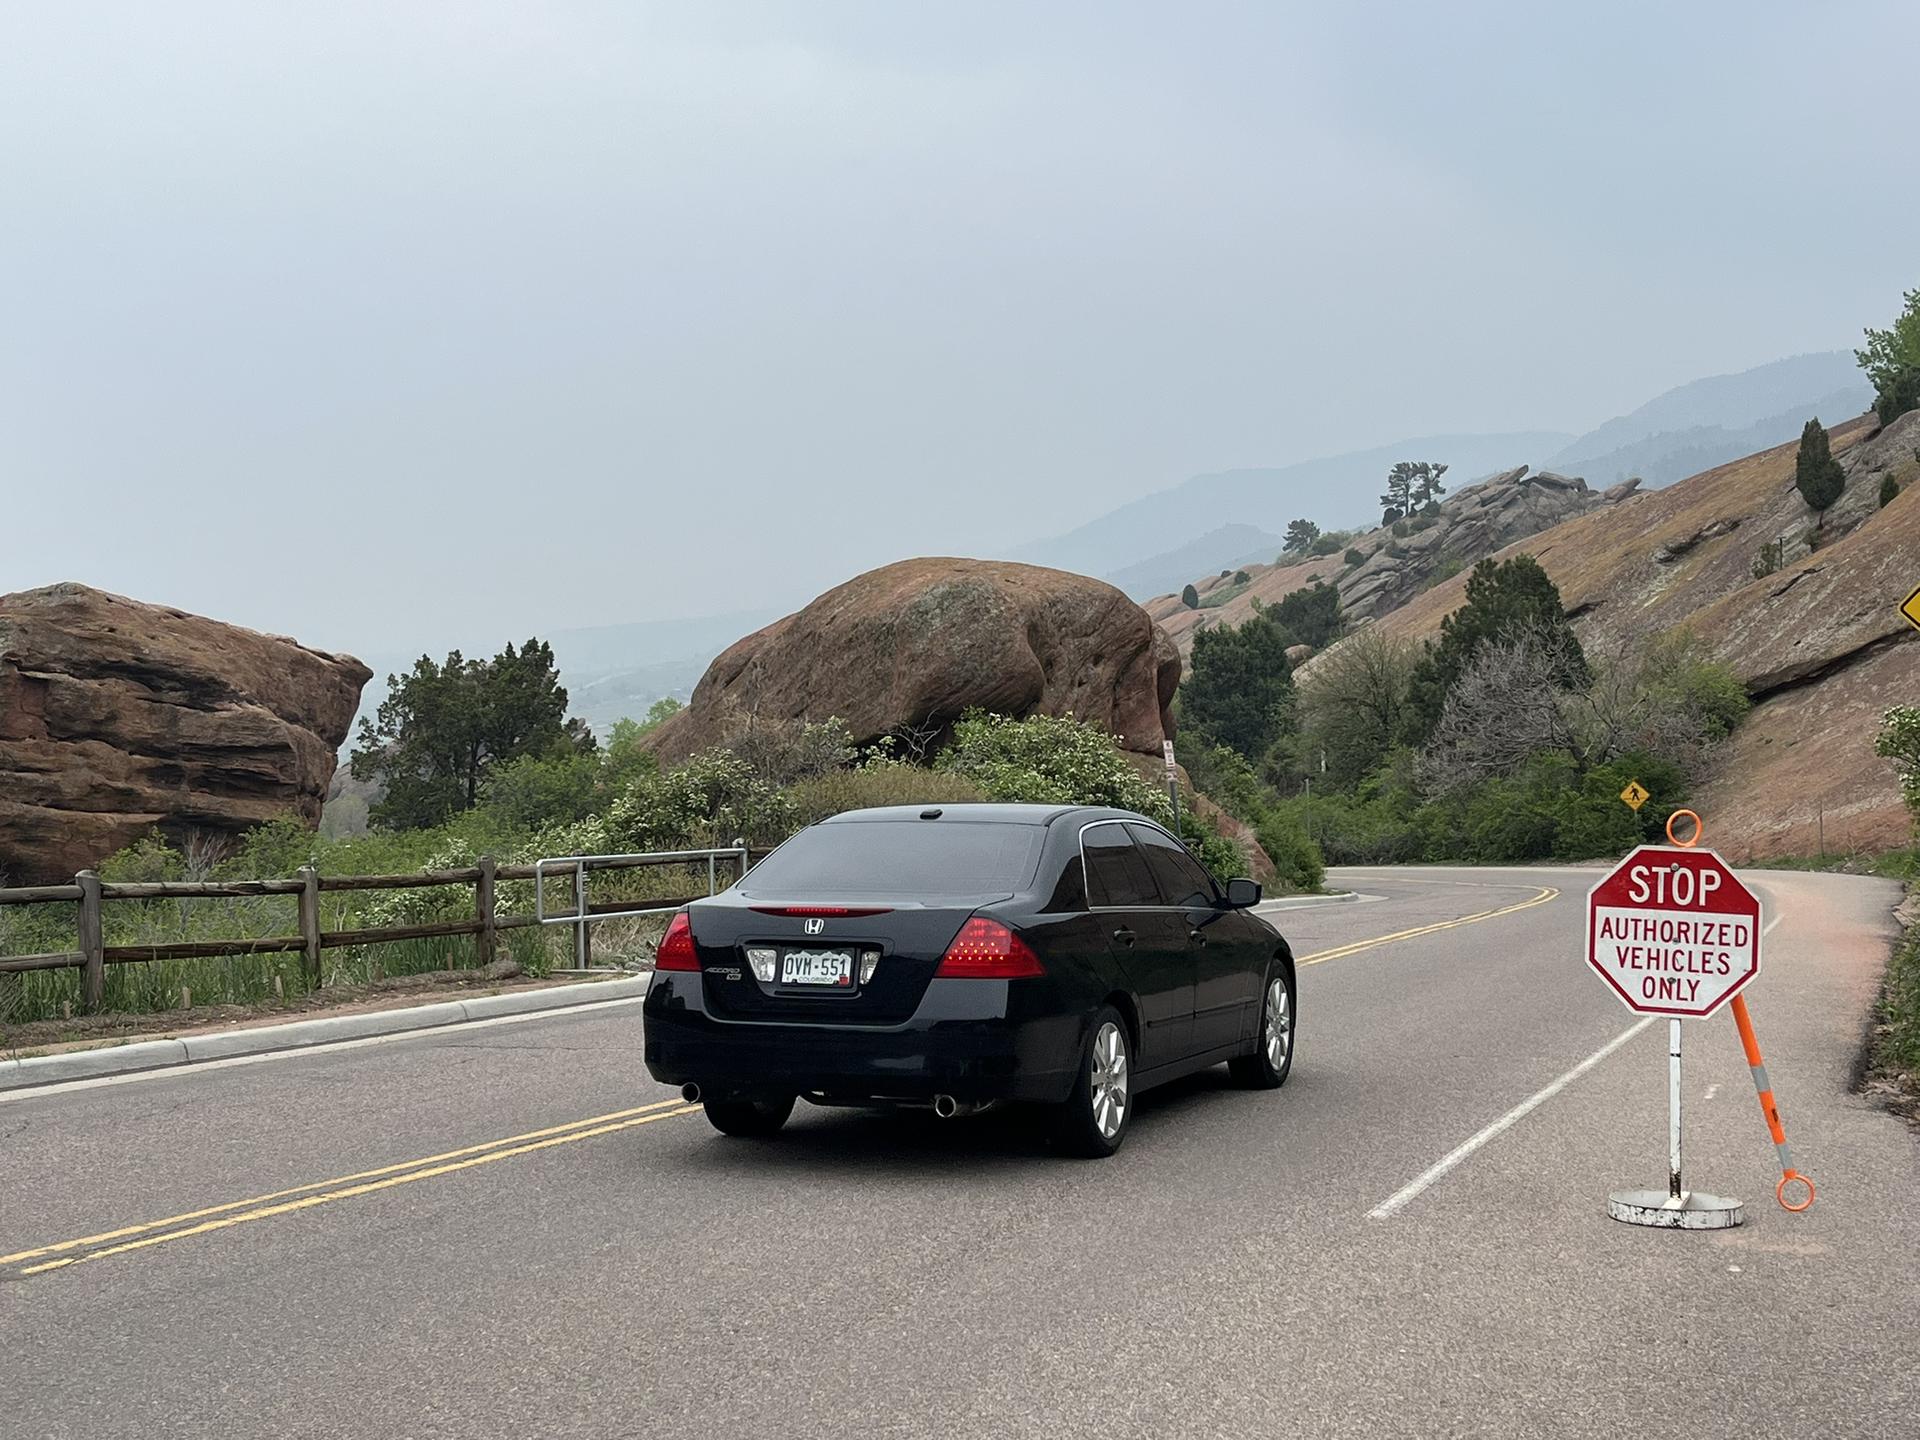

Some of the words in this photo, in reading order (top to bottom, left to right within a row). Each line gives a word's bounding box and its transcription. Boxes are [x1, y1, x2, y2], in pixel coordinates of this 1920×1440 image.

[1628, 865, 1722, 907] STOP
[1600, 917, 1749, 948] AUTHORIZED
[1616, 946, 1731, 976] VEHICLES
[1642, 975, 1701, 1002] ONLY
